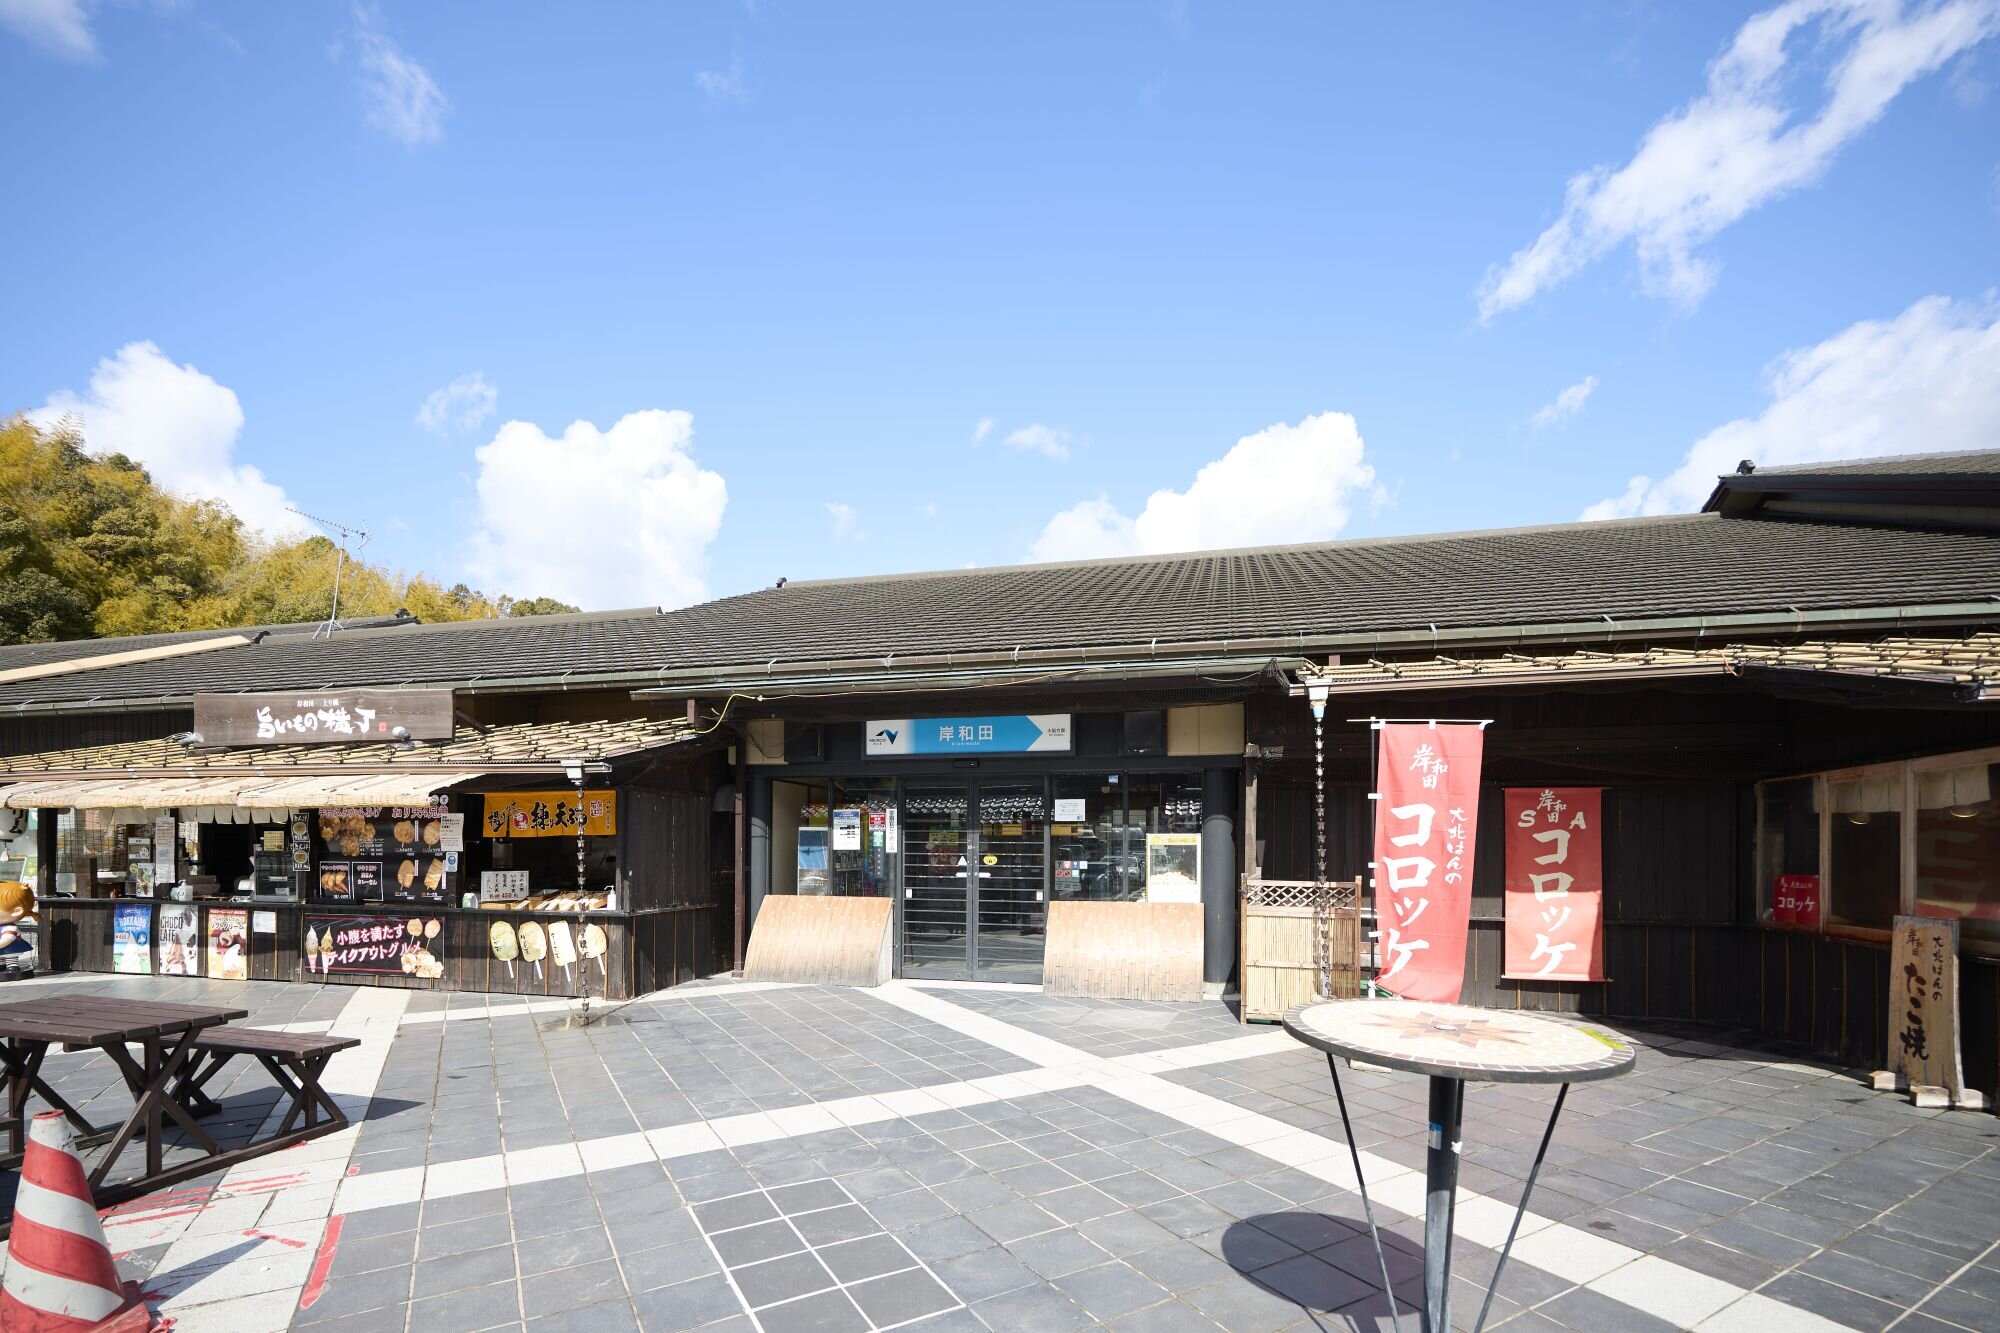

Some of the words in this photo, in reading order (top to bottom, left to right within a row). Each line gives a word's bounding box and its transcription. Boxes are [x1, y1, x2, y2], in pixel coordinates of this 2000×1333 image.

[257, 706, 376, 738] 旨いもの横丁
[939, 725, 993, 742] 岸和田
[1409, 743, 1448, 789] 岸和田
[1536, 789, 1567, 824] 岸和田
[1381, 803, 1437, 979] コロッケ
[1528, 829, 1577, 978] コロッケ
[1778, 896, 1816, 912] コロッケ
[119, 915, 147, 928] HOKKAIDO
[160, 916, 184, 929] CHOCO
[336, 923, 405, 946] 小腹を満たす
[160, 929, 176, 942] LATE
[327, 940, 421, 966] テイクアウトグルメ
[1900, 962, 1929, 1061] たこ焼
